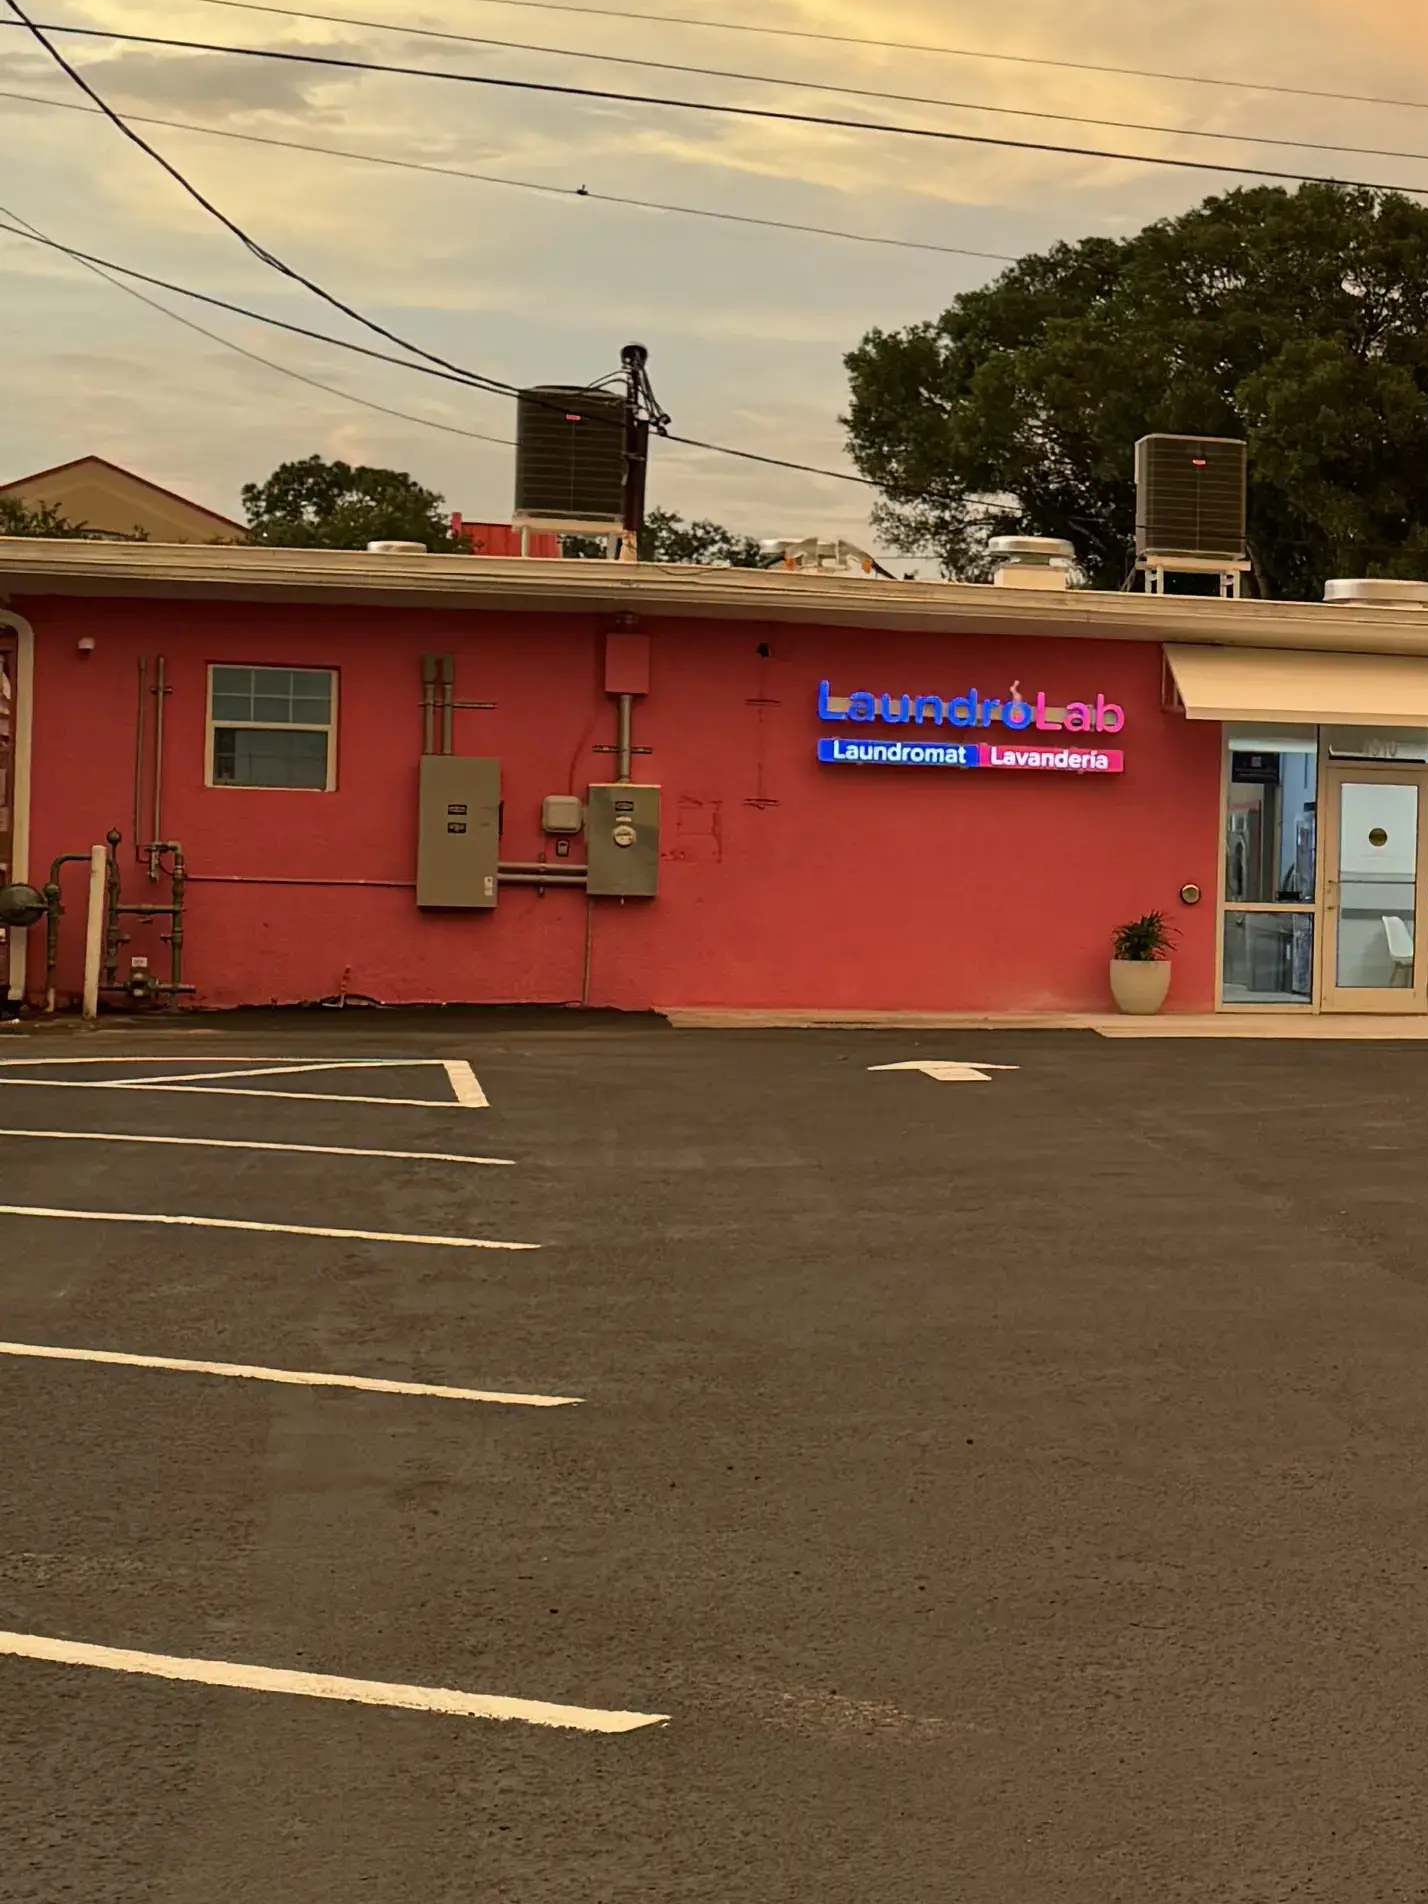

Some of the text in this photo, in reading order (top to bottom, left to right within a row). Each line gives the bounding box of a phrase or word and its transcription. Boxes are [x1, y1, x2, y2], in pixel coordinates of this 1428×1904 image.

[818, 680, 1125, 733] LaundroLab
[833, 739, 1109, 770] Laundromat Lavandería
